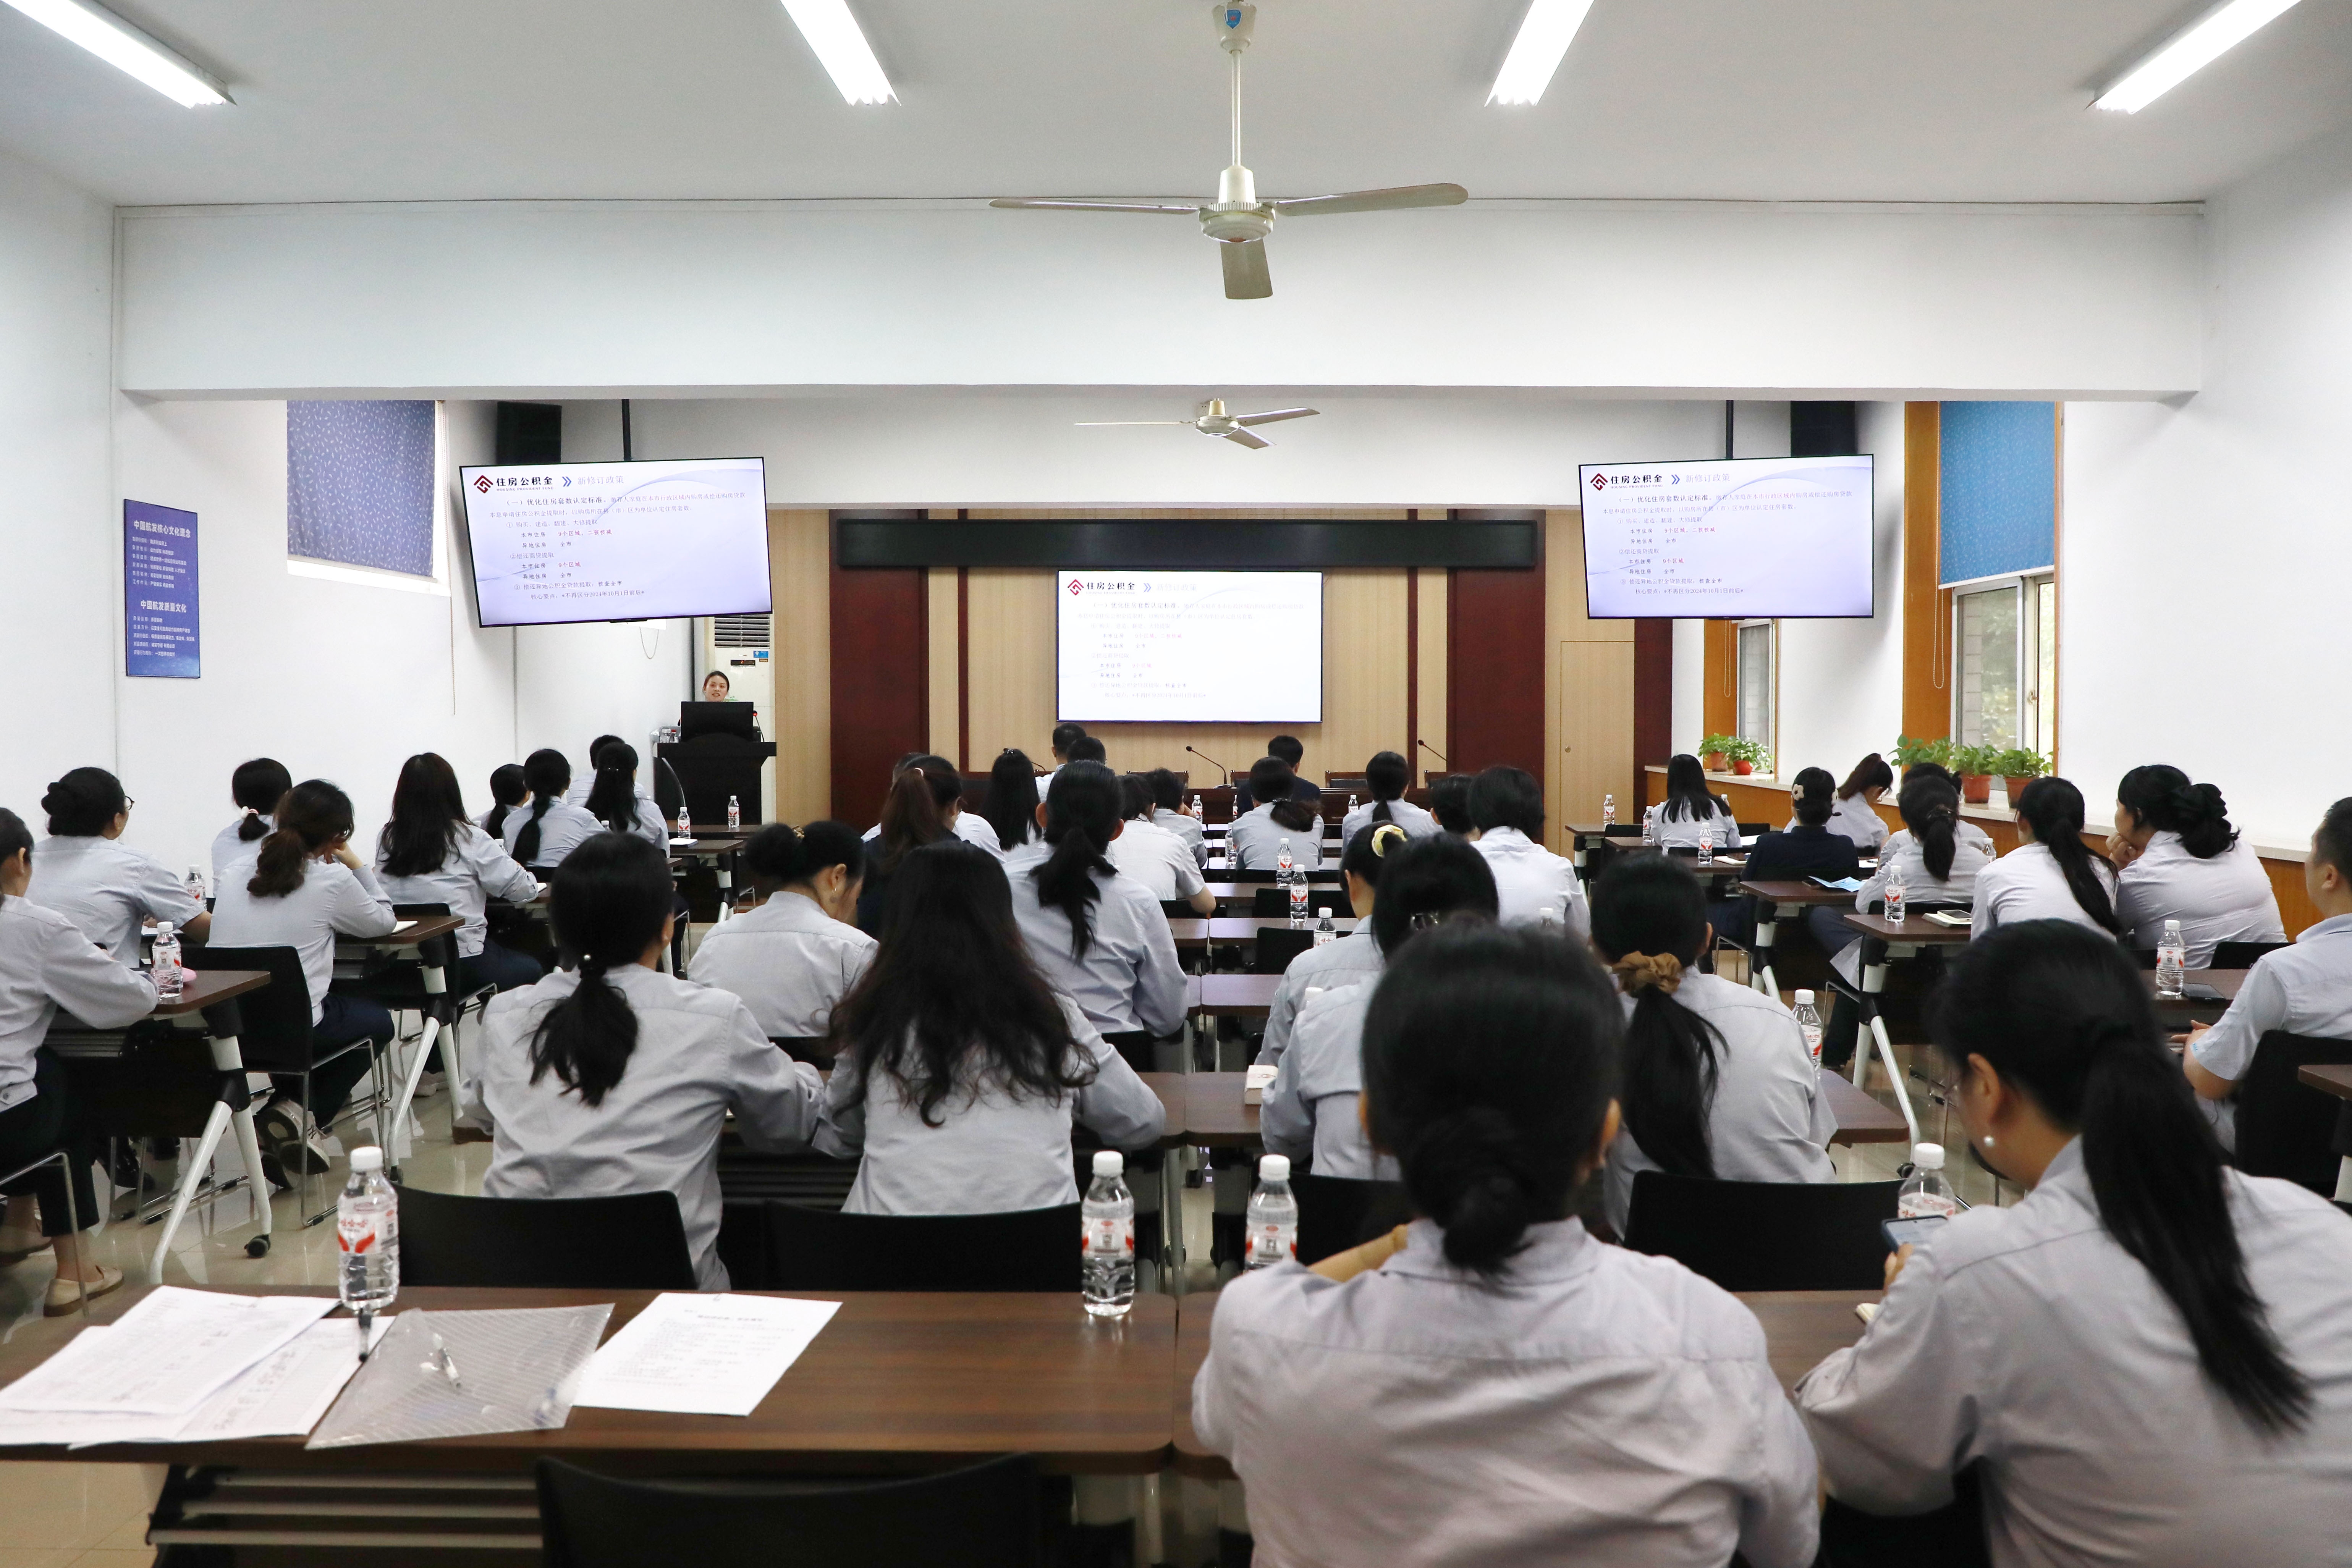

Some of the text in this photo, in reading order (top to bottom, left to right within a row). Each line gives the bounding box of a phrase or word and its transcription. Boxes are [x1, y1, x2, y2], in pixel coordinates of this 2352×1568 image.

[496, 475, 624, 487] 住房公积金 新修订政策
[1611, 473, 1731, 484] 住房公积金 新修订政策
[134, 520, 191, 538] 中国航发核心文化理念
[141, 600, 187, 613] 中国航发质量文化
